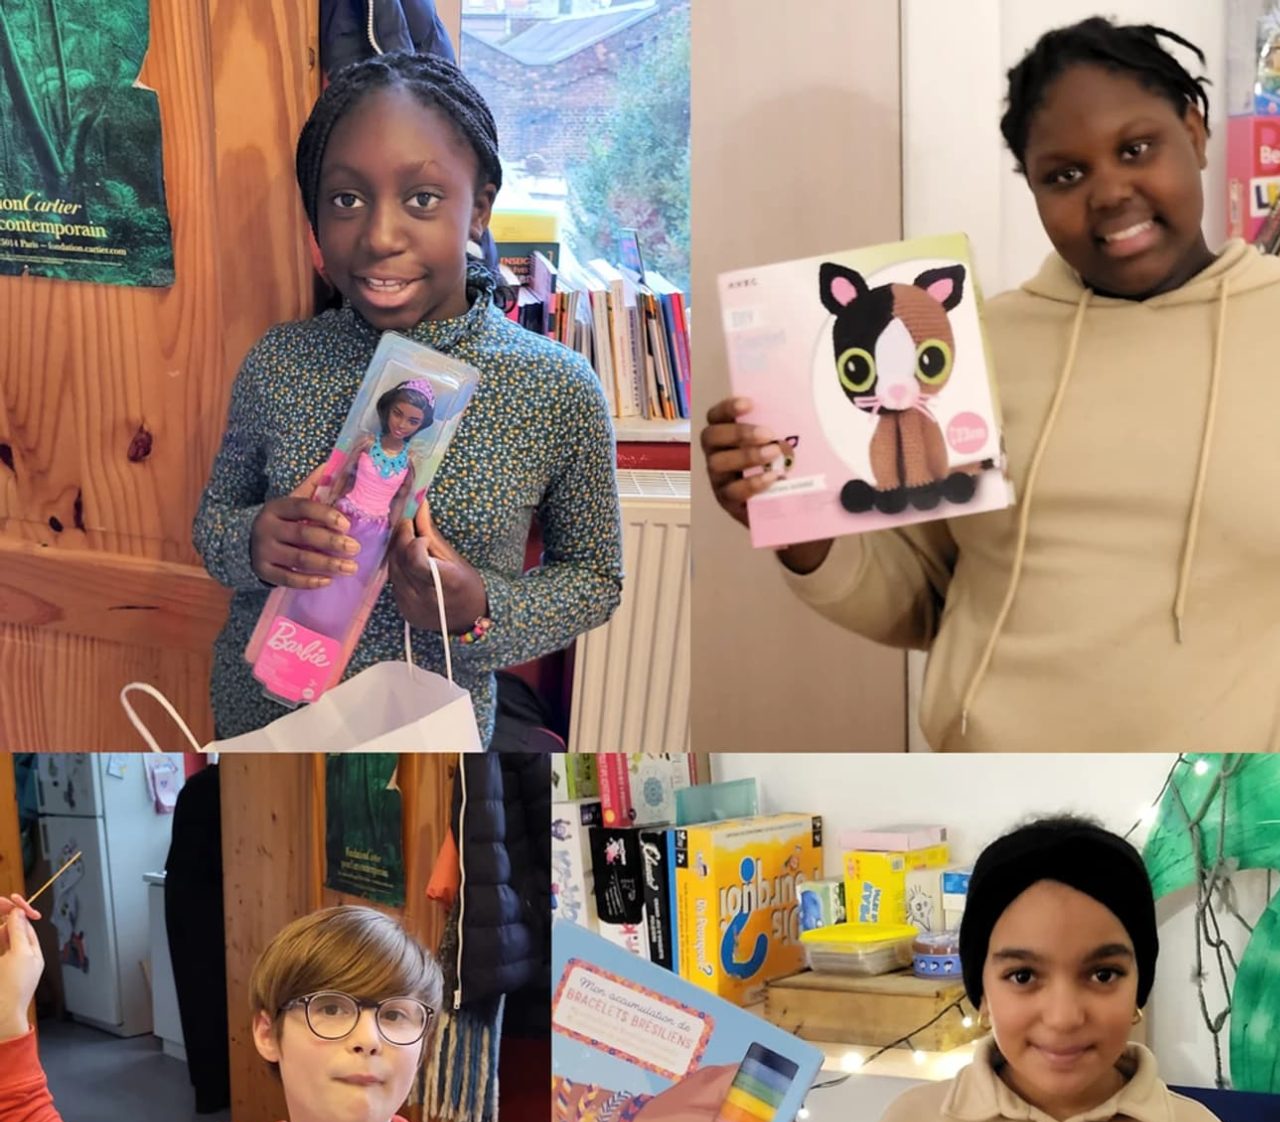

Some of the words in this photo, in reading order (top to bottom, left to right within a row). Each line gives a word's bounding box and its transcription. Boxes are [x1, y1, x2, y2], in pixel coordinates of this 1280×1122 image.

[0, 218, 108, 240] contemporain
[267, 621, 331, 668] Barbie
[565, 987, 630, 1023] BRACELETS
